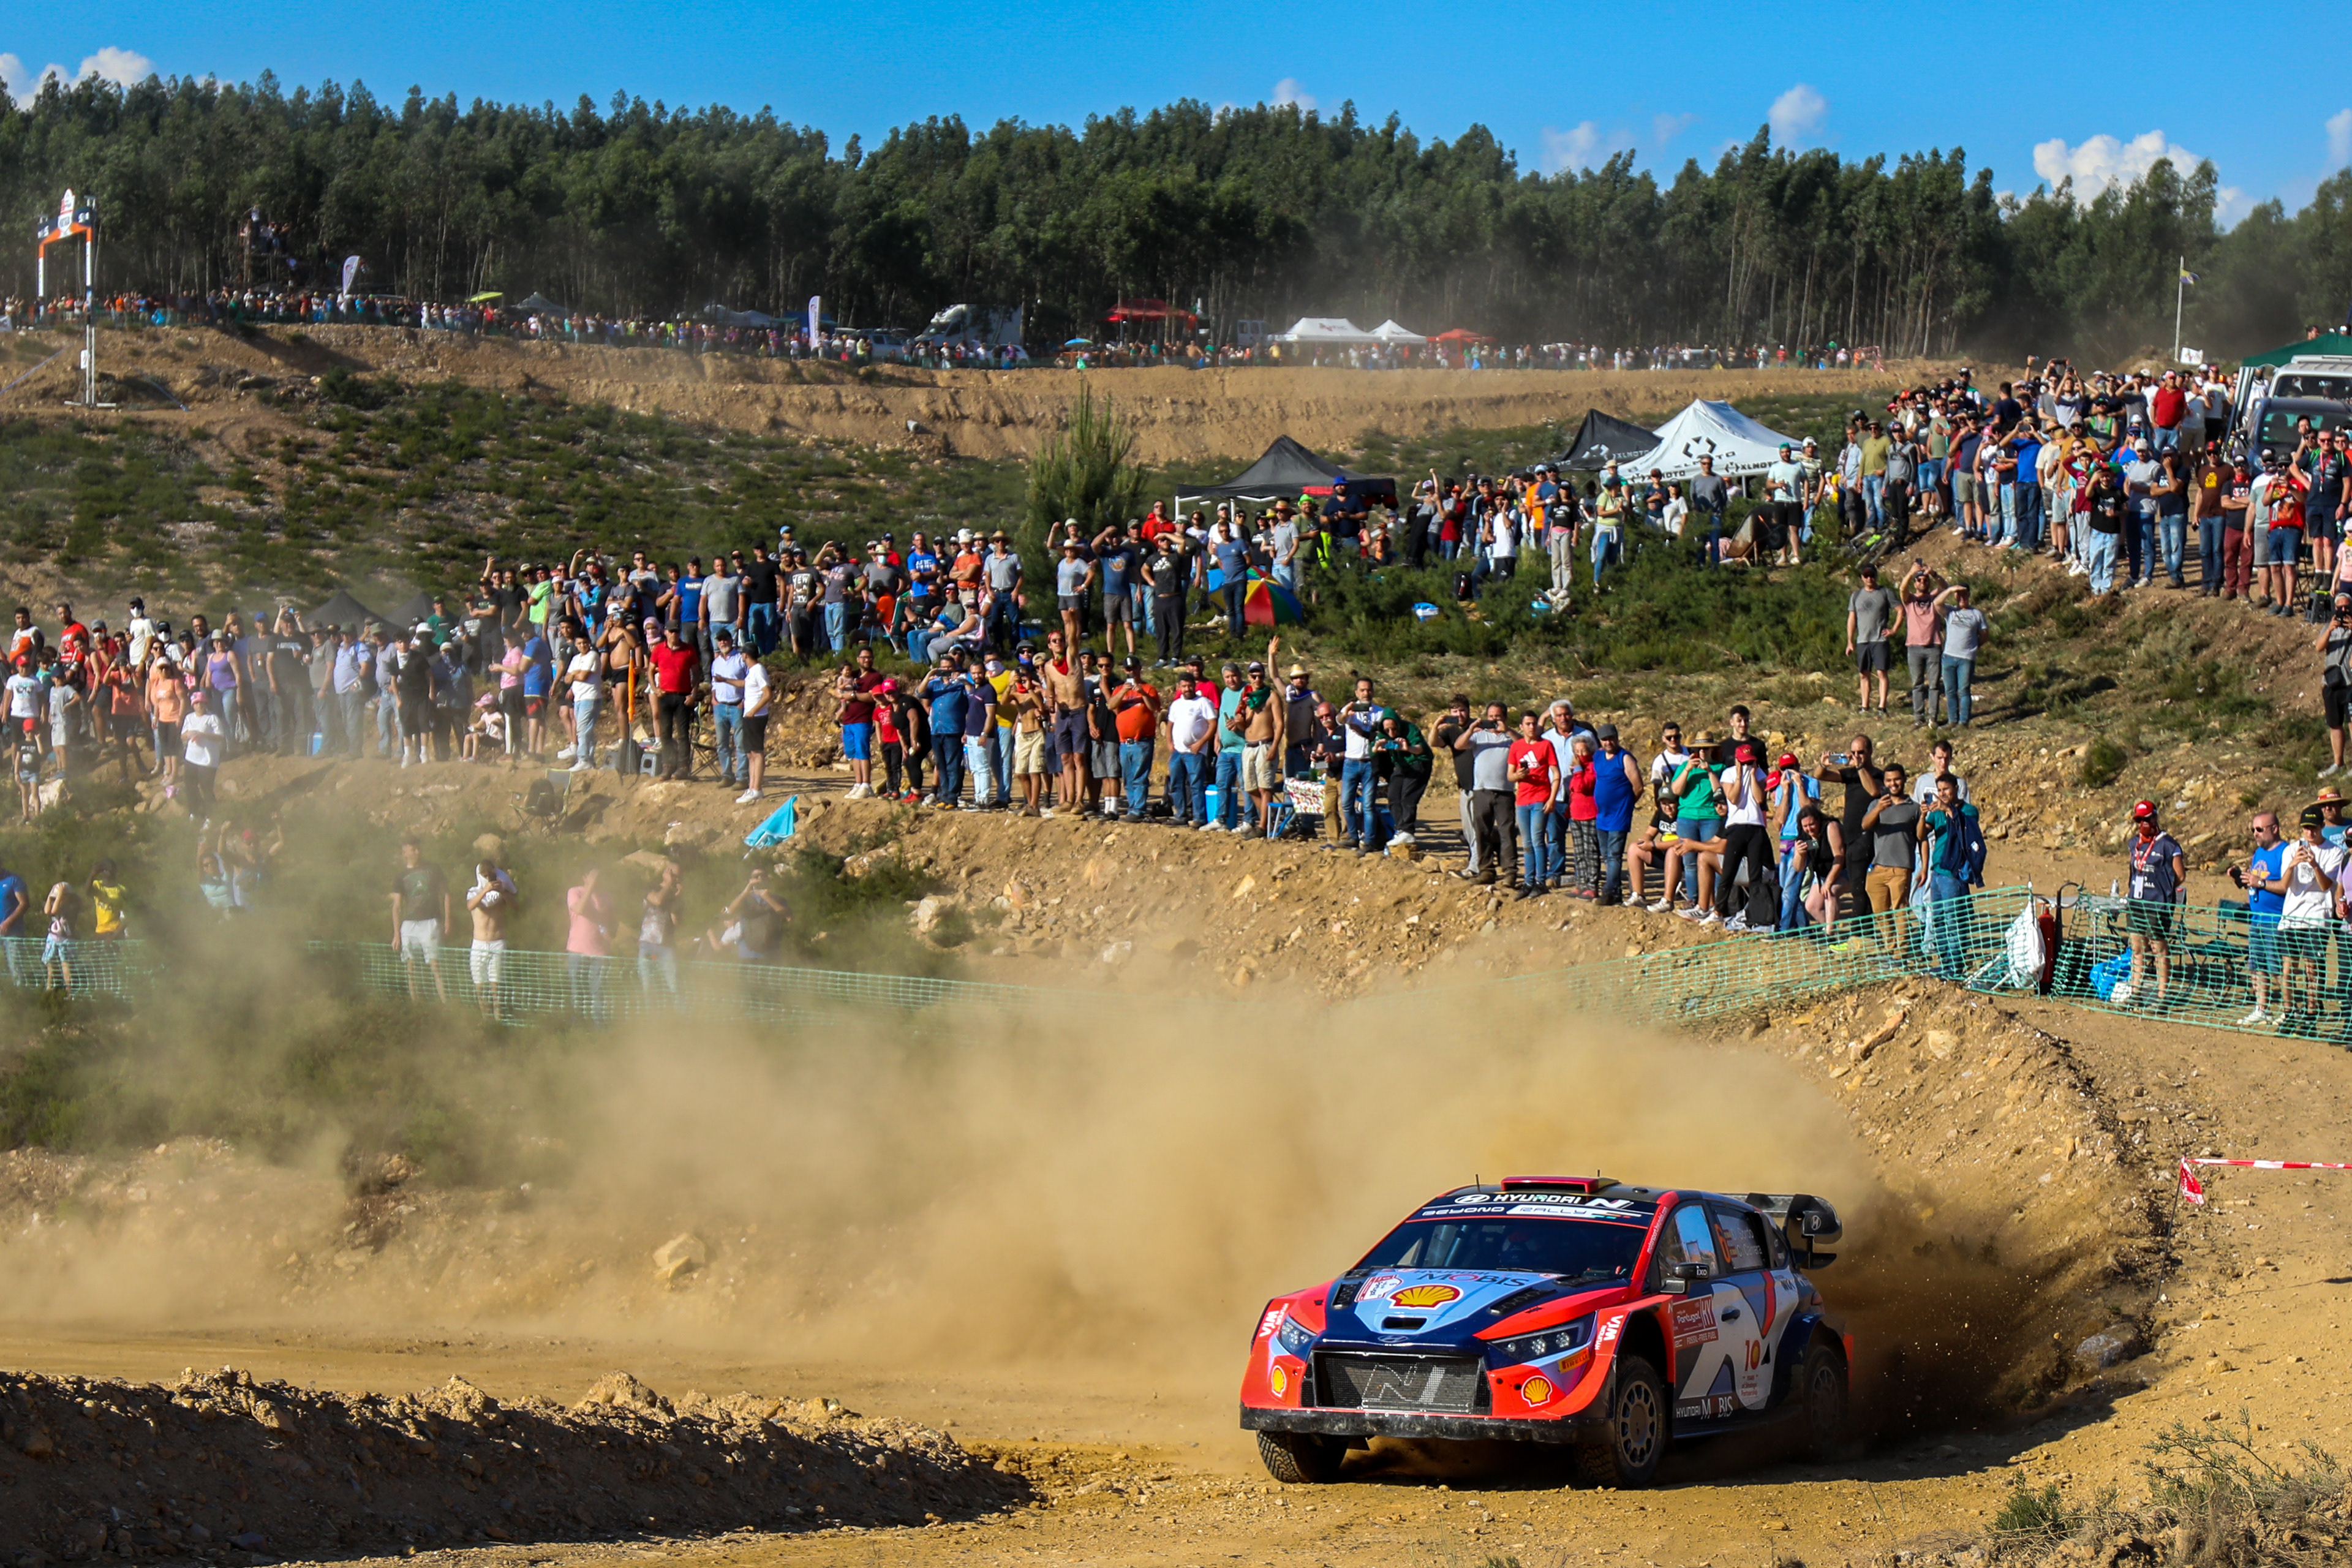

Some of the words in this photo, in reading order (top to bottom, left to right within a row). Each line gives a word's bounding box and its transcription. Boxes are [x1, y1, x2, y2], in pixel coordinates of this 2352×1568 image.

[1740, 460, 1777, 470] XLMOT
[1493, 1194, 1581, 1204] HYUNDAI
[1422, 1207, 1505, 1216] BEYOND
[1416, 1273, 1530, 1287] MOBIS
[1259, 1310, 1280, 1338] WIA
[1676, 1310, 1702, 1324] Portugal
[1603, 1314, 1624, 1341] WIA
[1562, 1350, 1588, 1370] PIRELLI
[1676, 1404, 1701, 1418] HYUNDAI
